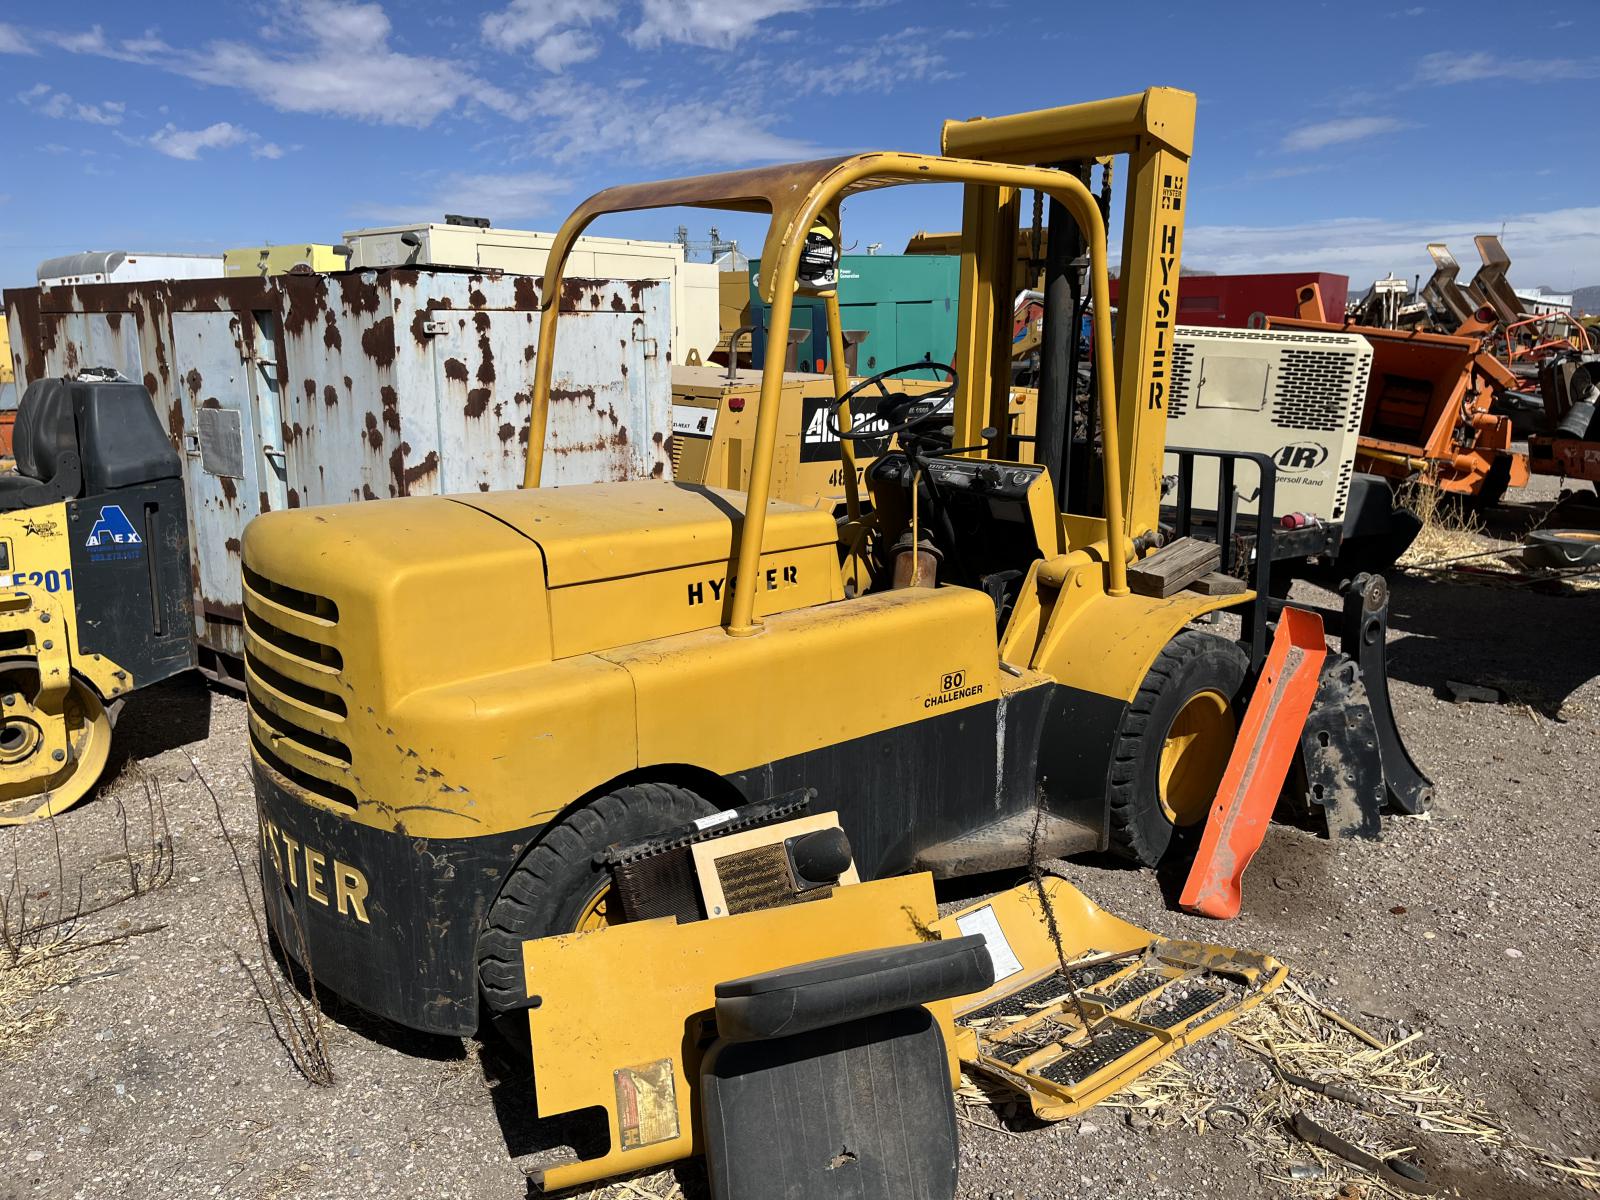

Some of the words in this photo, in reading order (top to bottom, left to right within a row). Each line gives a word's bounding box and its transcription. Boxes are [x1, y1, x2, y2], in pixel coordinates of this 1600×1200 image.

[1162, 189, 1182, 197] HYSTER
[1148, 224, 1177, 410] HYSTER
[1279, 446, 1318, 468] IR
[829, 467, 864, 487] 487
[1275, 476, 1301, 484] gersoll
[1302, 478, 1324, 486] Rand
[687, 565, 798, 606] HYER
[943, 672, 963, 690] 80
[924, 684, 983, 708] CHALLENGER
[260, 817, 371, 924] STER
